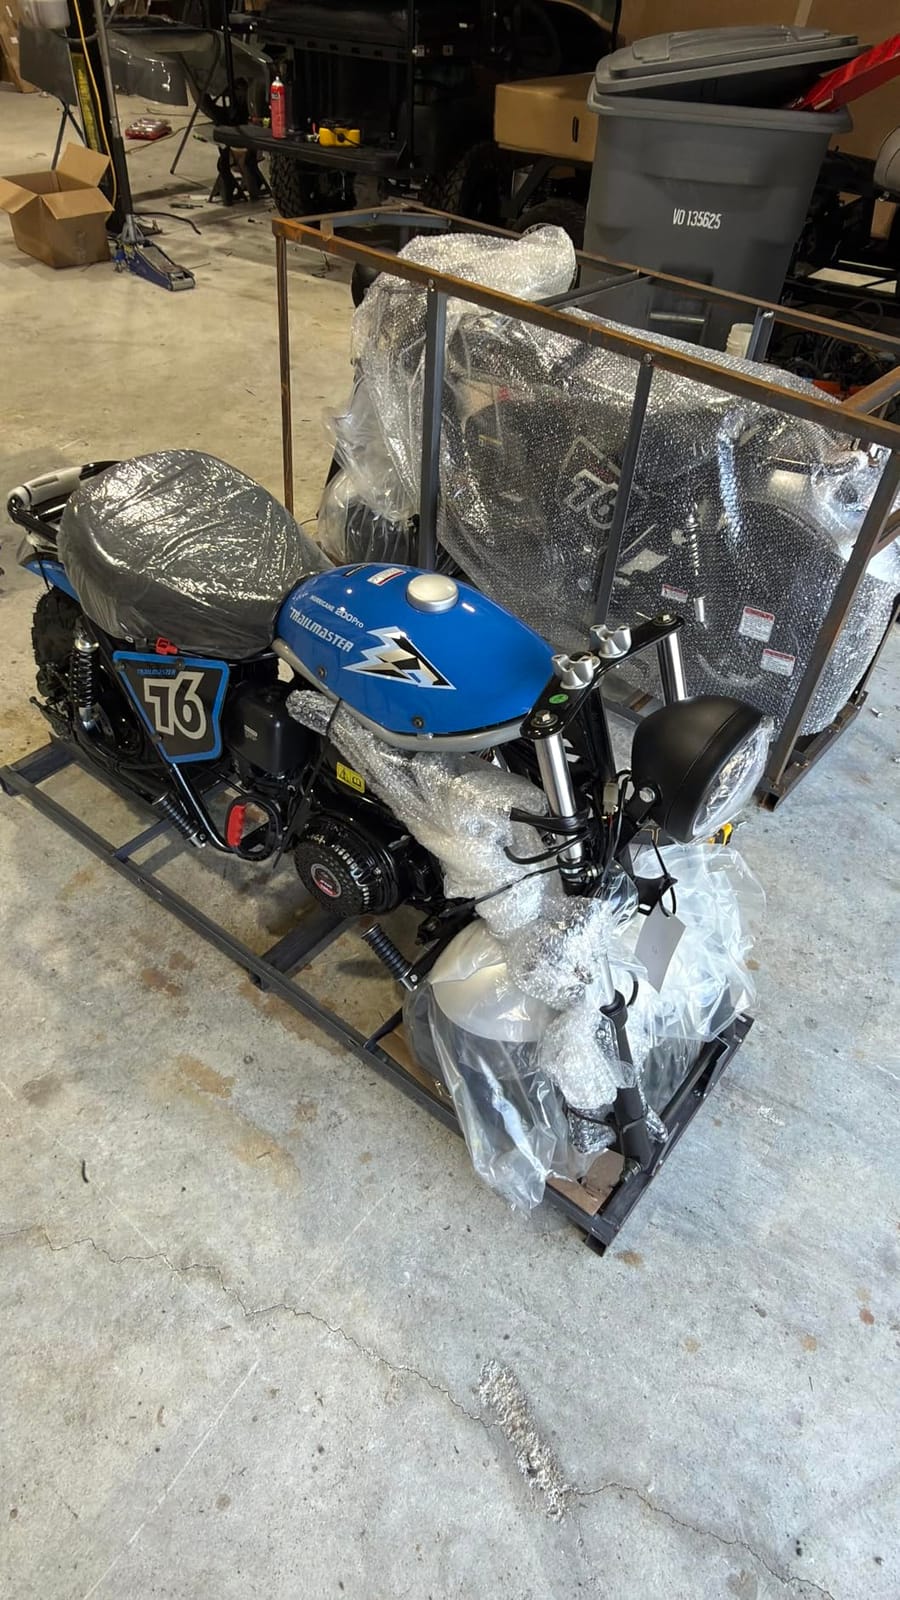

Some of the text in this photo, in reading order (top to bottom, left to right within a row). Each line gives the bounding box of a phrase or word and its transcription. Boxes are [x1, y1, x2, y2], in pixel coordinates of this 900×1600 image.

[686, 210, 722, 230] 135625
[309, 595, 335, 612] HURRICANE
[289, 607, 354, 653] TRAILMASTER
[143, 671, 207, 740] 76
